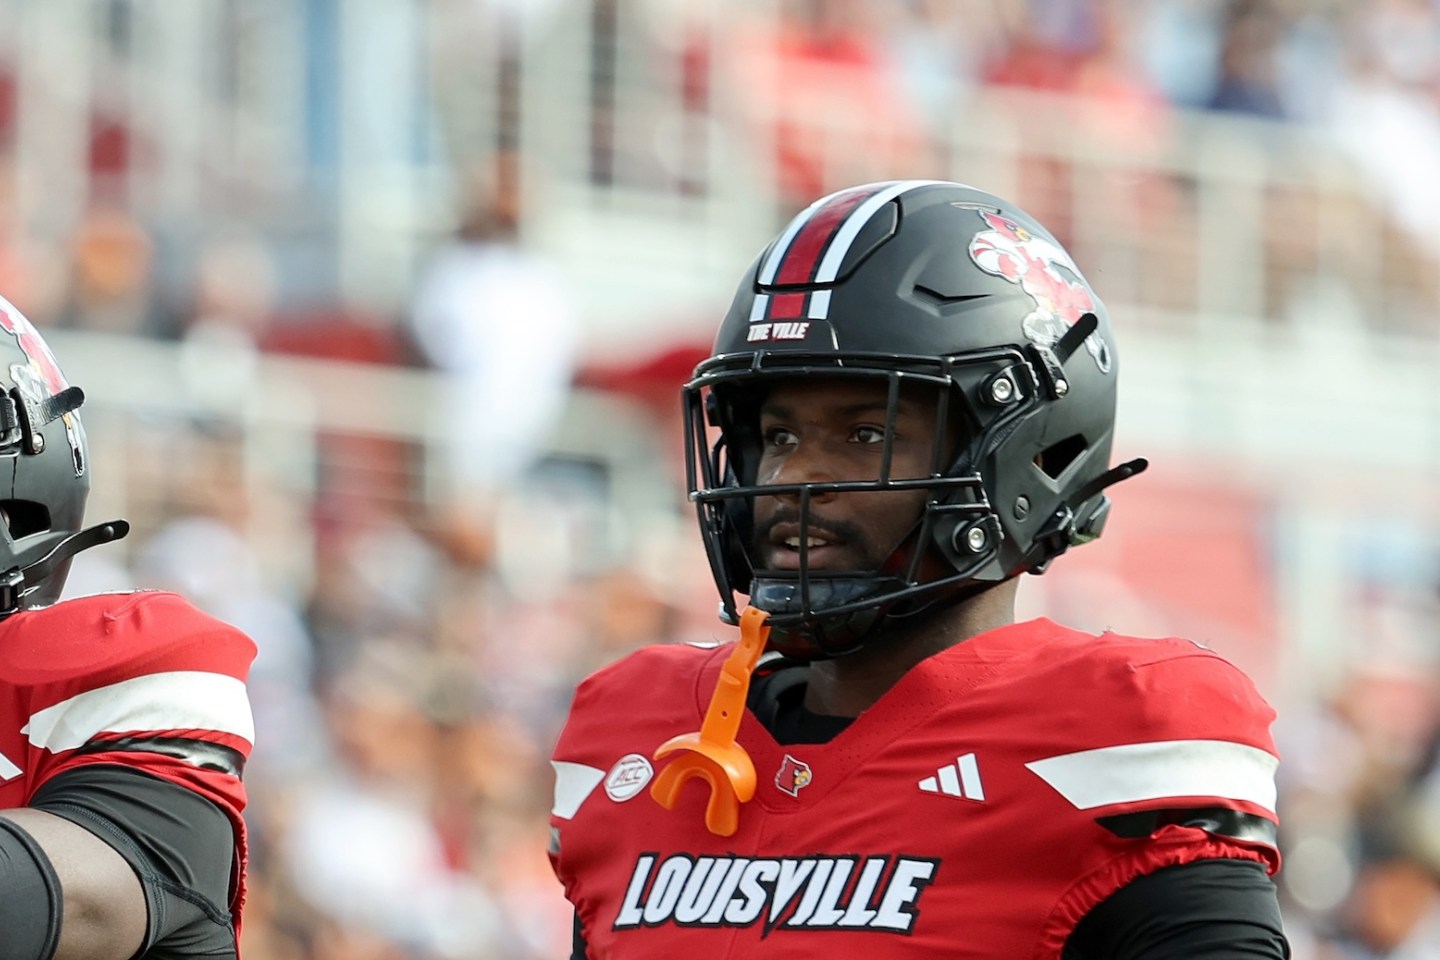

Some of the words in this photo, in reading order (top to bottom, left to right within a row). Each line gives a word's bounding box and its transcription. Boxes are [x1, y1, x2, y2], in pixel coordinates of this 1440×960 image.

[746, 323, 773, 342] THE
[772, 322, 810, 340] VILLE
[611, 766, 648, 785] ACC
[613, 852, 941, 938] LOUISVILLE
